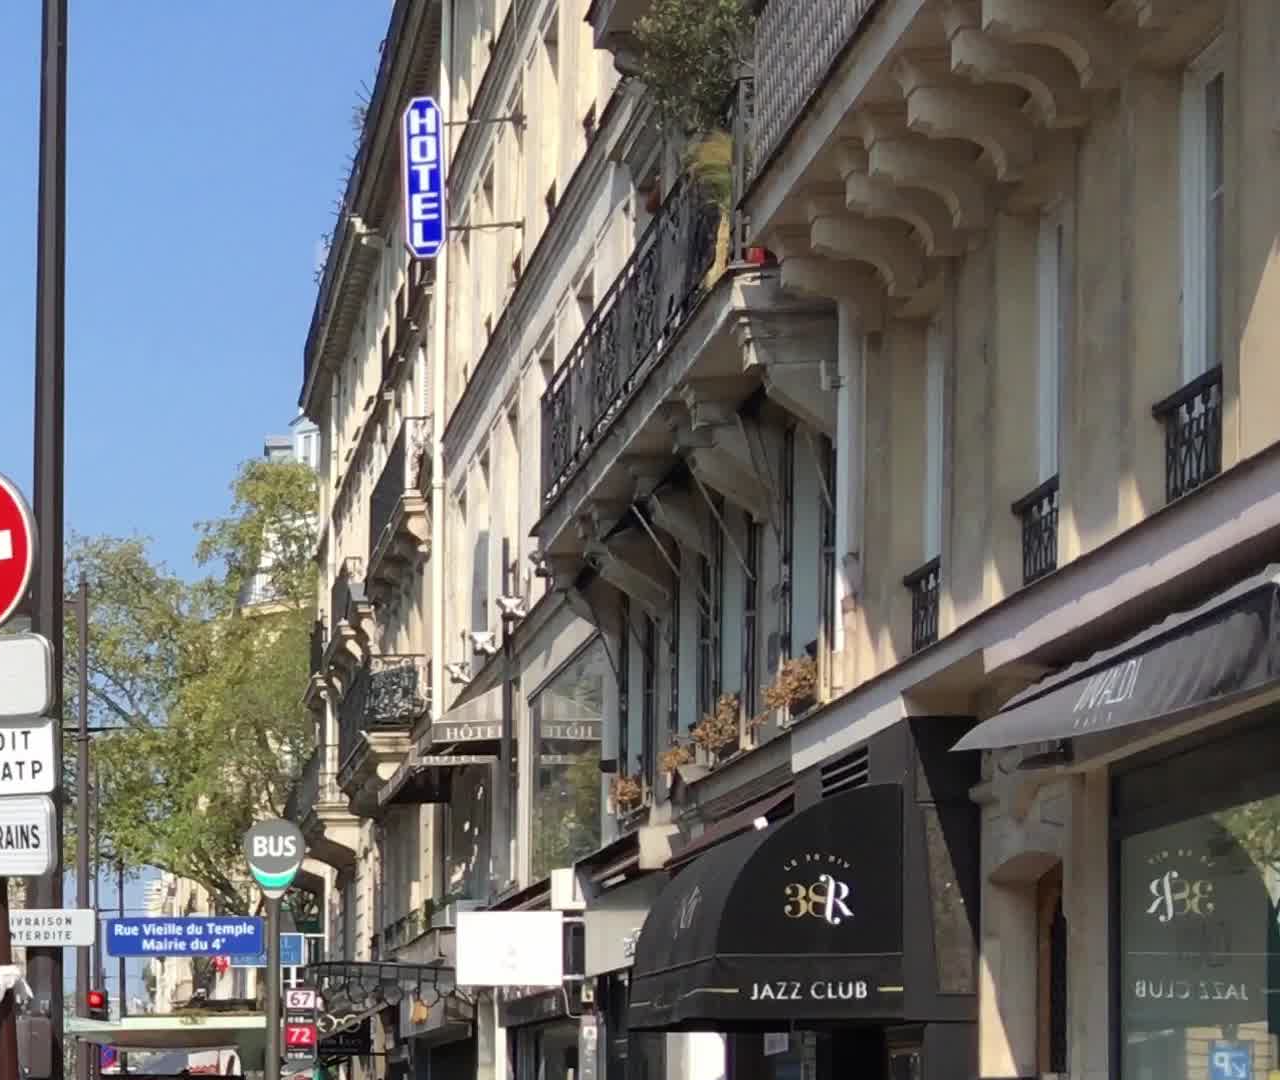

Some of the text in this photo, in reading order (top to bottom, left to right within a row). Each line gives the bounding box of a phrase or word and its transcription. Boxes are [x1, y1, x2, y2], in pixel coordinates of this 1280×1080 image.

[410, 108, 440, 248] HOTEL
[253, 836, 297, 857] BUS
[11, 917, 72, 926] IVRAISON
[10, 931, 72, 940] NTERDITE
[114, 922, 255, 936] Rue Vieille du Temple
[142, 939, 186, 950] Mairie
[191, 938, 208, 950] du
[750, 980, 868, 1000] JAZZ CLUB
[290, 992, 311, 1006] 67
[290, 1028, 311, 1042] 72
